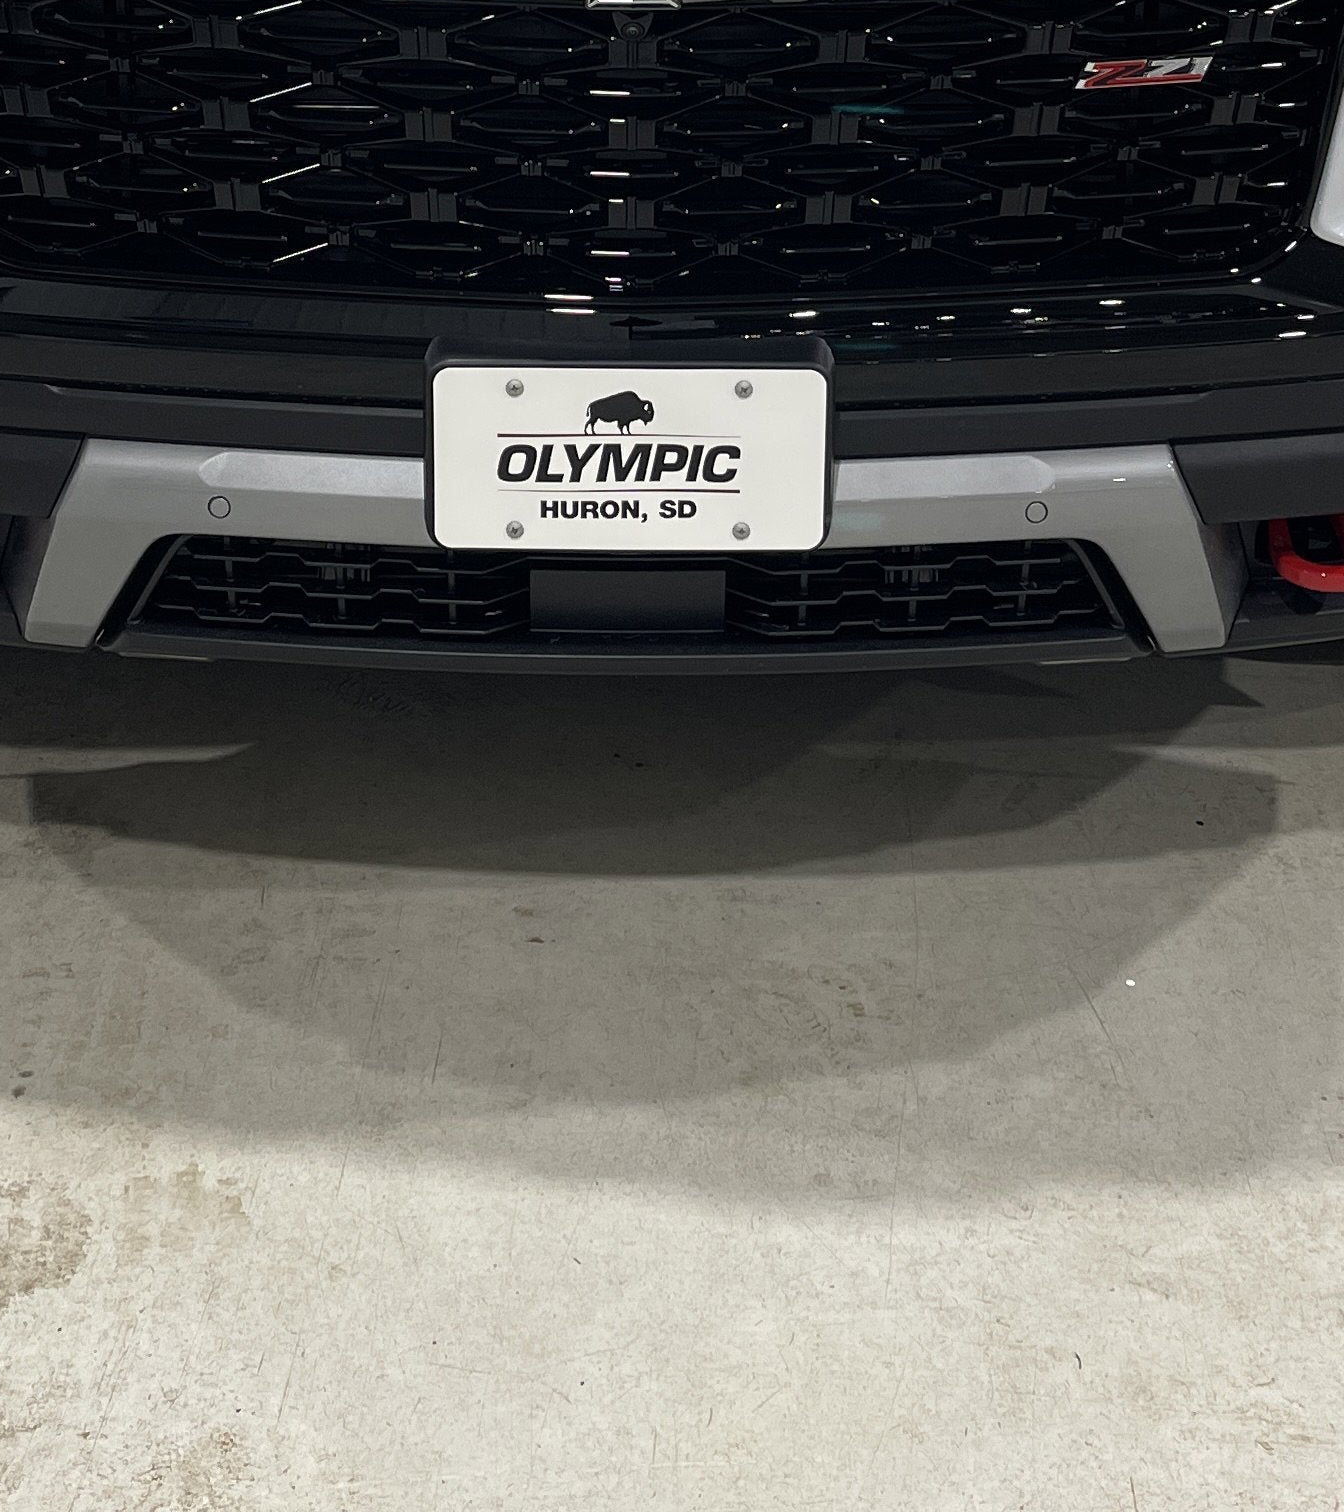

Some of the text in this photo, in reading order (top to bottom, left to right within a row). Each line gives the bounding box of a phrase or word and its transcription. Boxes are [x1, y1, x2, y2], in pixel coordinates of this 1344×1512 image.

[1075, 56, 1213, 90] Z71
[496, 443, 741, 484] OLYMPIC
[540, 499, 697, 523] HURON, SD
